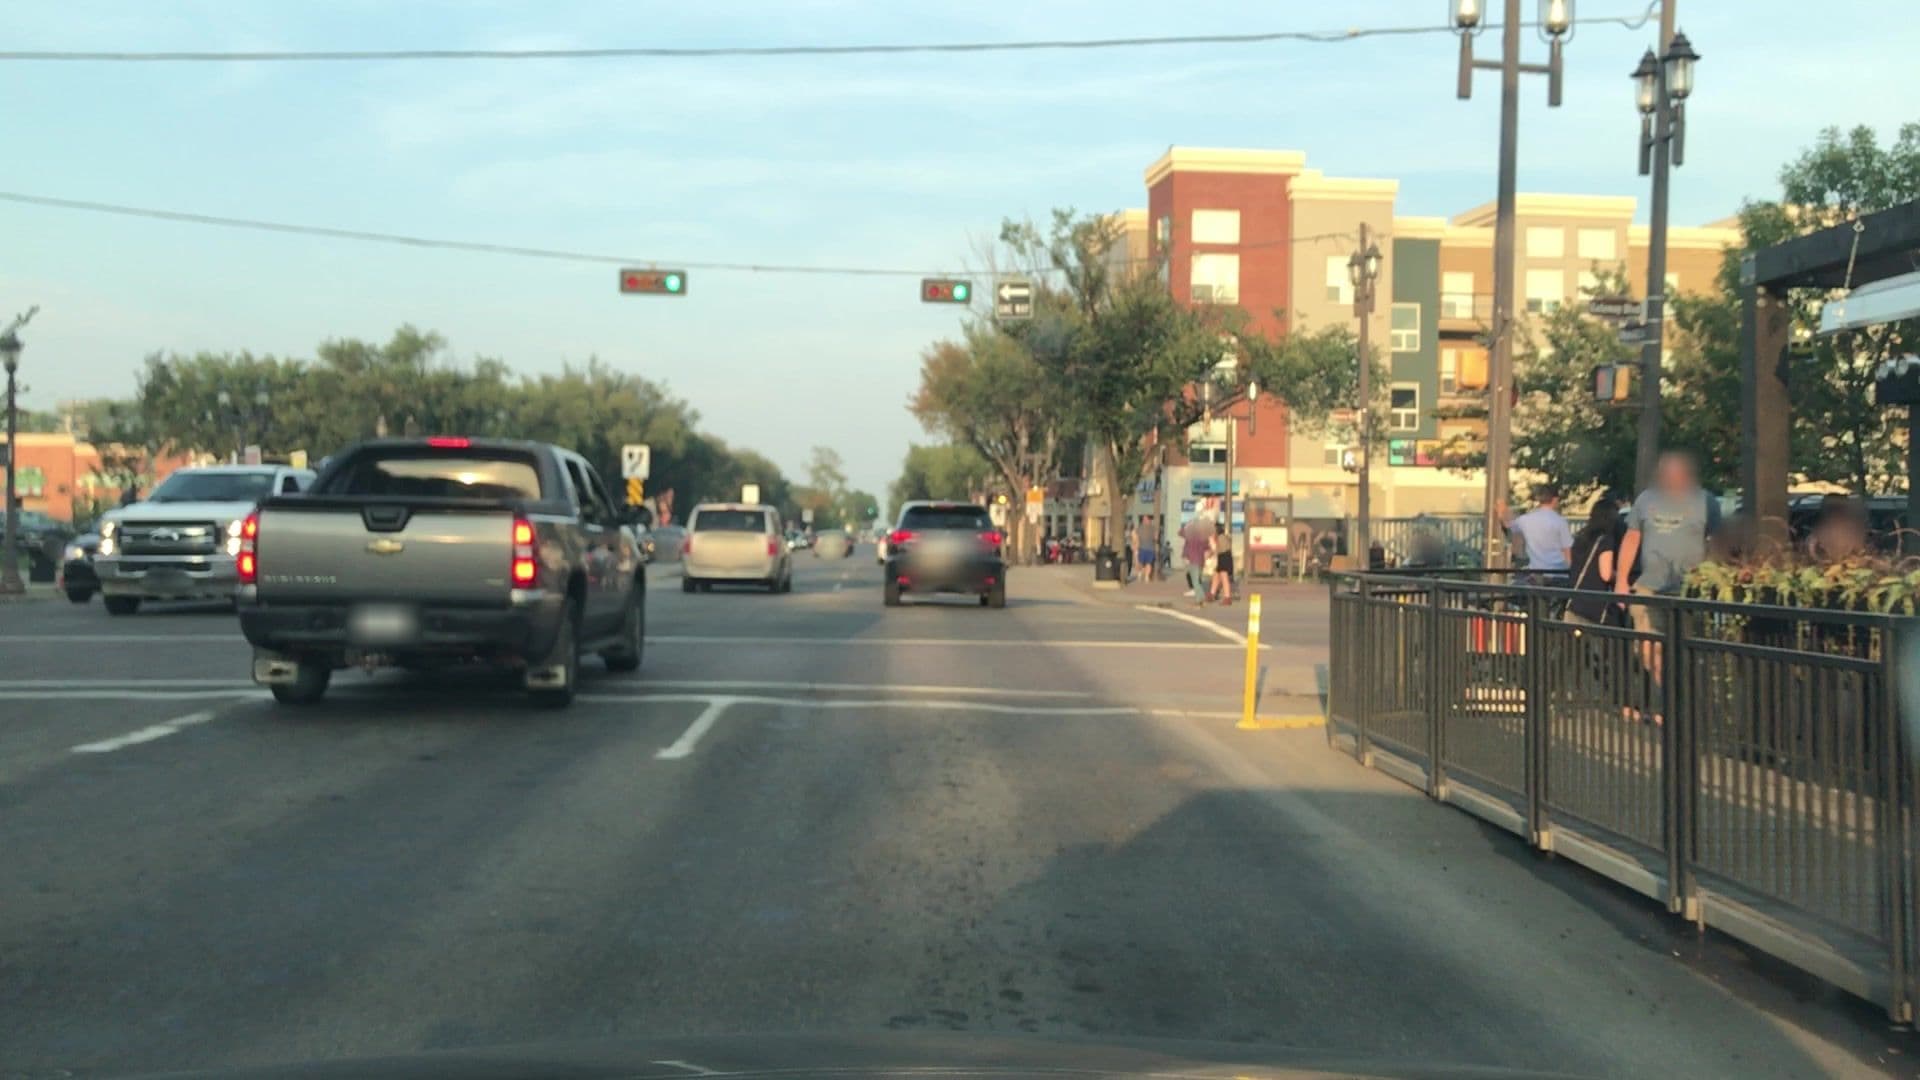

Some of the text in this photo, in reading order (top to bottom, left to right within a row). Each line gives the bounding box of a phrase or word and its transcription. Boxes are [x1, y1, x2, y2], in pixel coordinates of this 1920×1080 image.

[998, 304, 1029, 315] ONE WAY
[1590, 303, 1622, 316] Gateway
